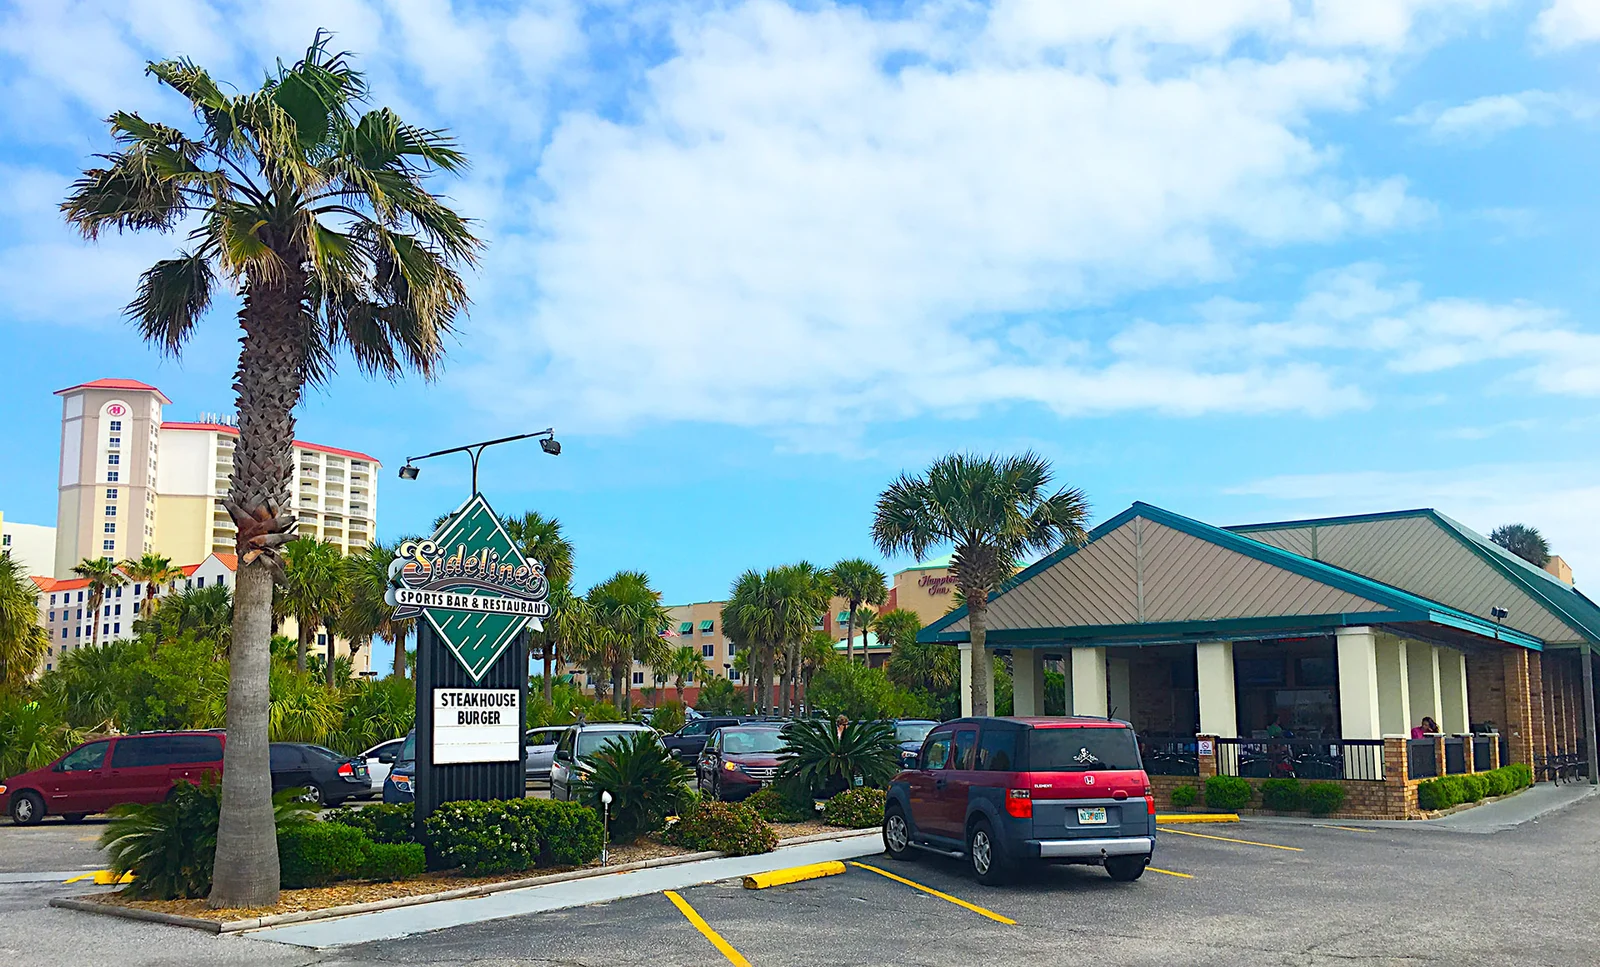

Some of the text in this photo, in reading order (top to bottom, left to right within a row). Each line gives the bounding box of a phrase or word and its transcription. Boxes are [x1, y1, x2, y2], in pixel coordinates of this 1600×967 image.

[399, 540, 547, 593] Sidelines
[928, 584, 950, 596] Inn
[400, 590, 547, 615] SPORTS BAR & RESTAURANT
[441, 692, 516, 707] STEAKHOUSE
[457, 710, 501, 725] BURGER
